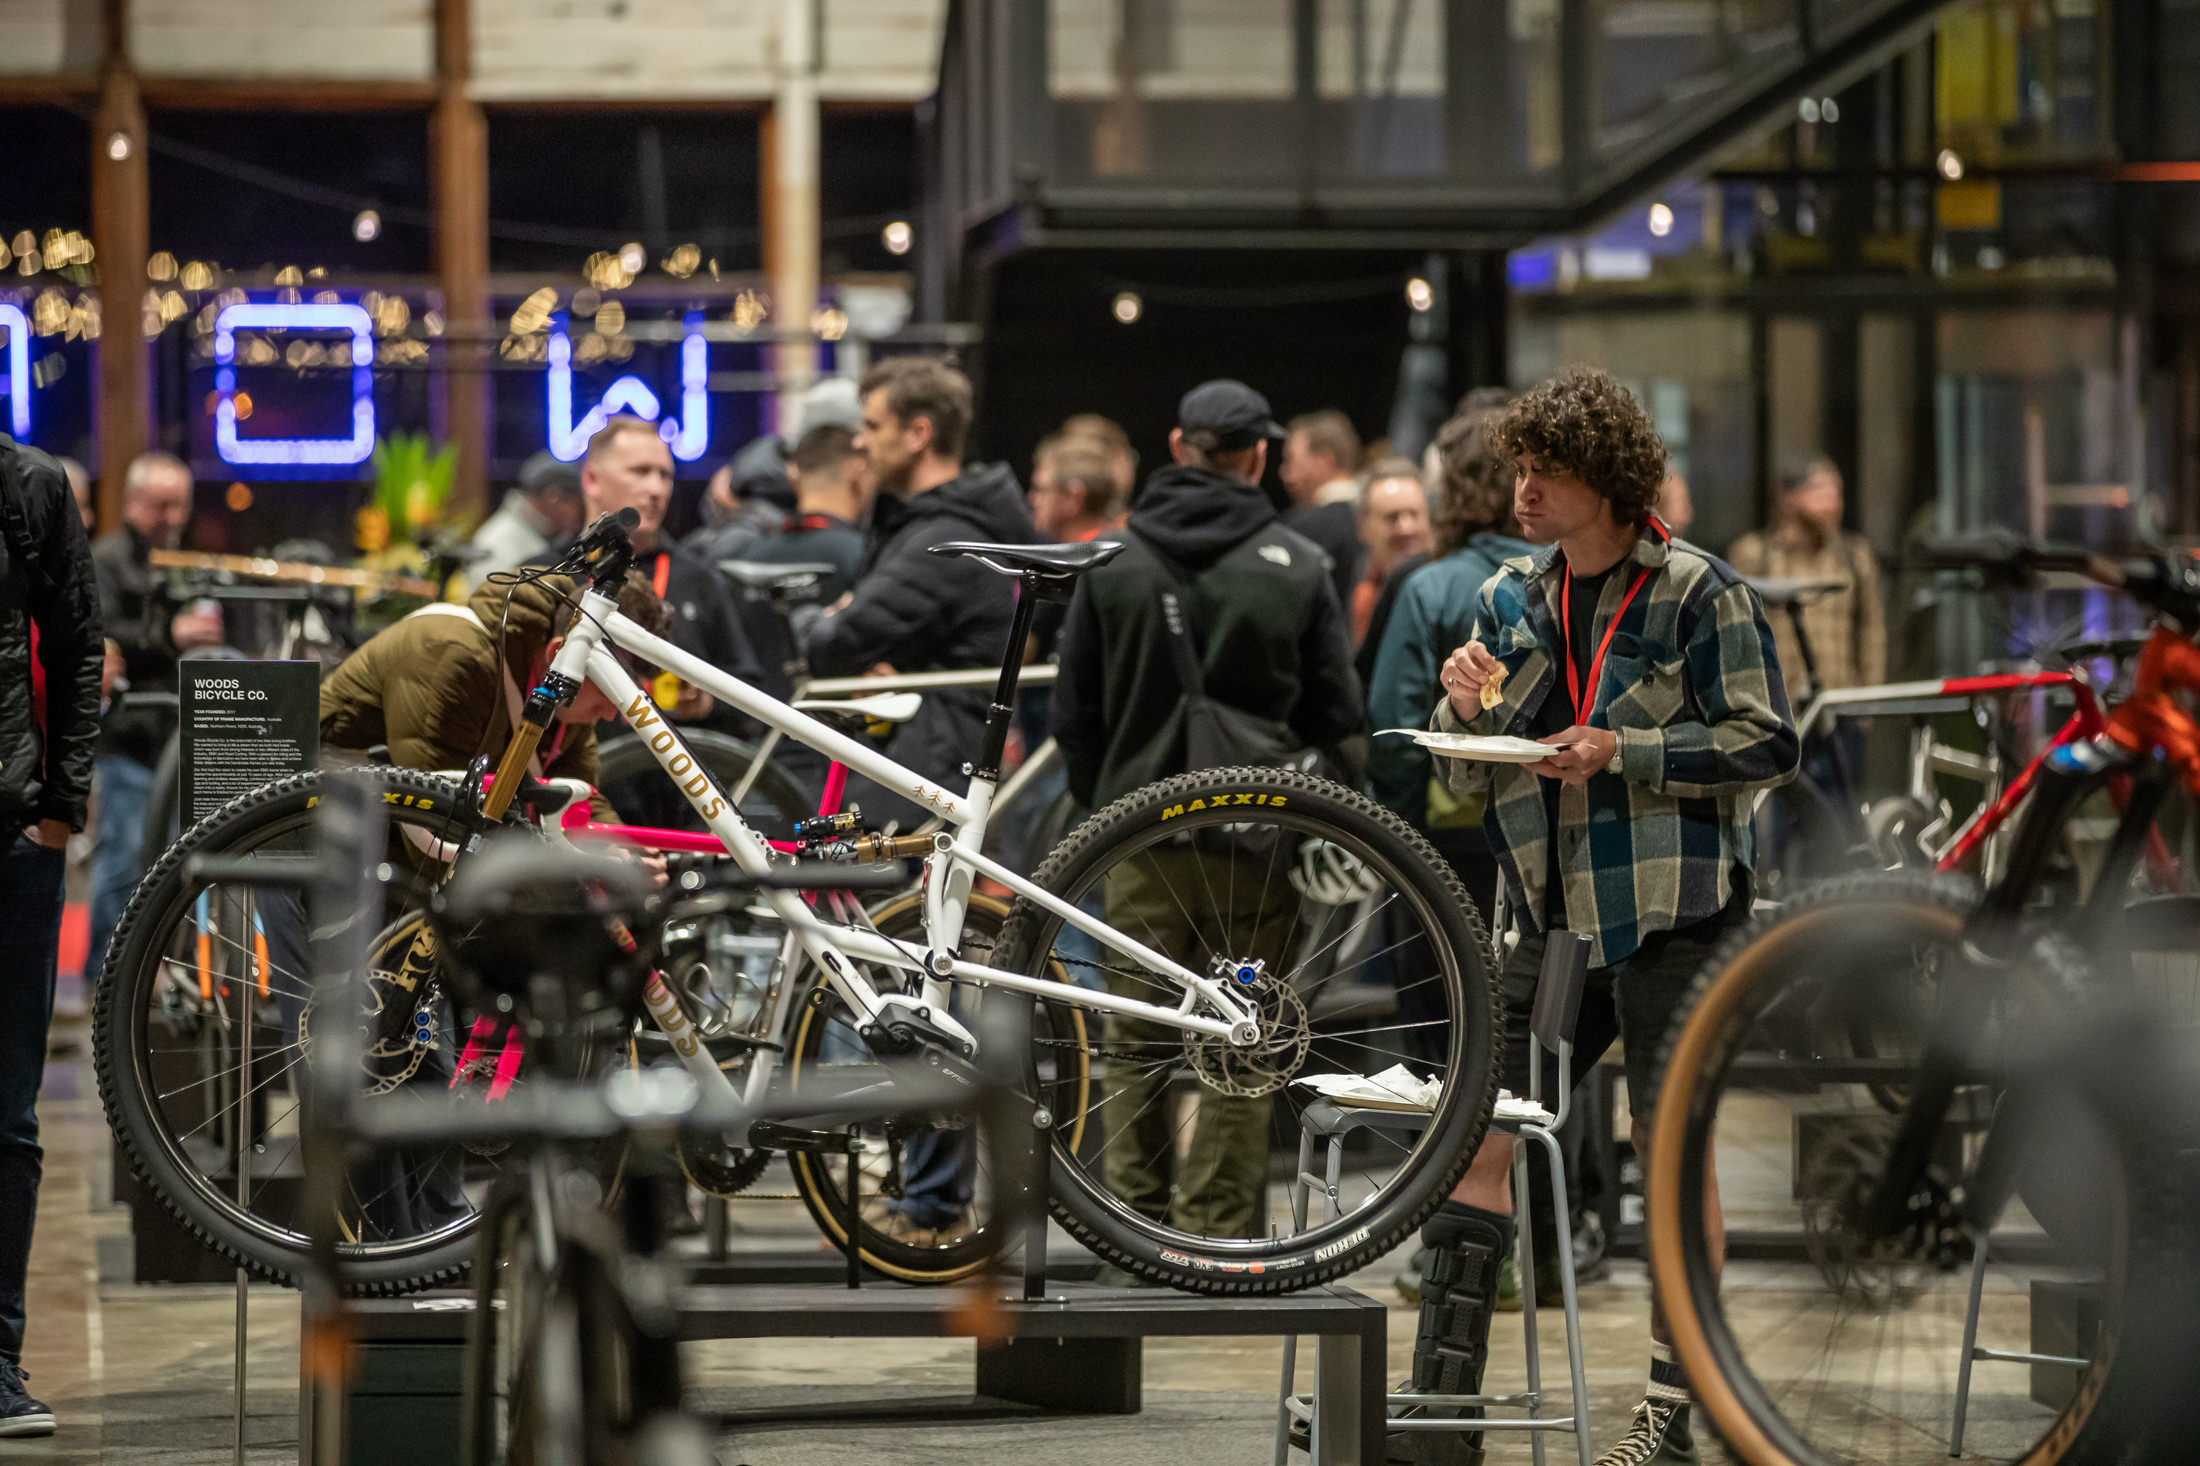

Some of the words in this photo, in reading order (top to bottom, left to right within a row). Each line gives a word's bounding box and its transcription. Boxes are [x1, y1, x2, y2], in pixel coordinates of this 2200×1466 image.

[194, 679, 239, 689] WOODS
[194, 690, 245, 701] BICYCLE
[247, 690, 269, 701] CO.
[626, 694, 727, 820] WOODS
[1161, 793, 1288, 821] MAXXIS
